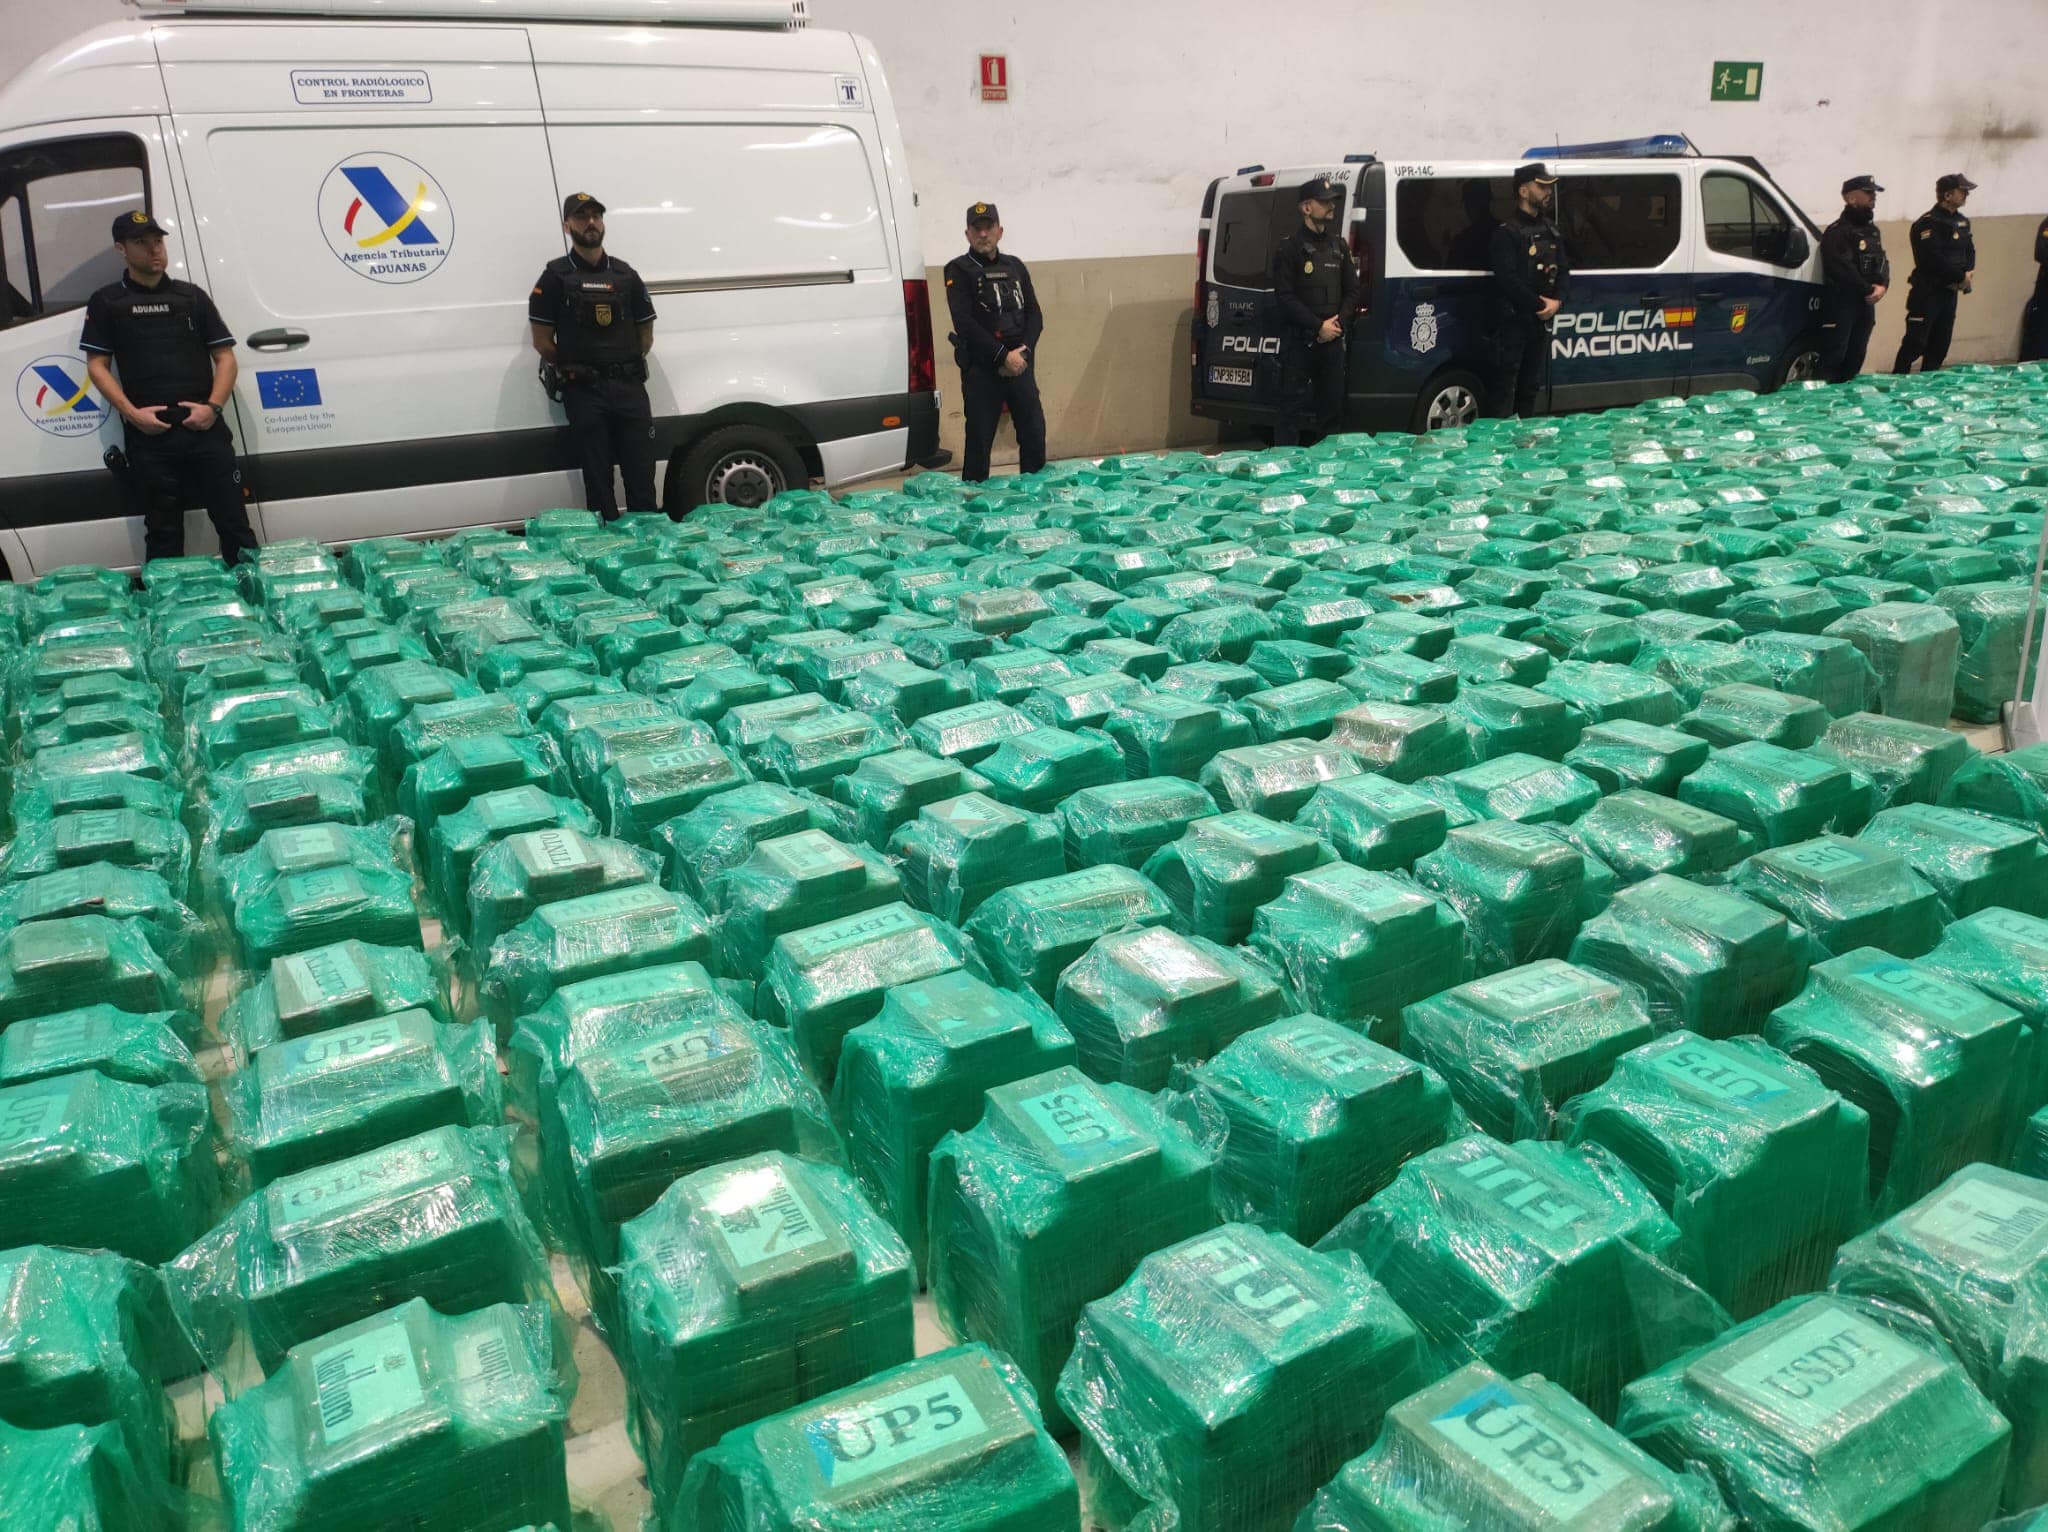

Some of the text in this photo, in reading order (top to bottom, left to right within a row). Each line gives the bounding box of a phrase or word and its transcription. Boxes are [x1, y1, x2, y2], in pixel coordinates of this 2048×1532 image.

[297, 76, 425, 87] CONTROL RADIÓLOGICO
[323, 88, 405, 98] EN FRONTERAS
[1394, 166, 1434, 176] UPR-14C
[343, 248, 446, 263] Agencia Tributaria
[369, 262, 427, 275] ADUANAS
[1222, 336, 1280, 354] POLICI
[1552, 331, 1694, 360] NACIONAL
[264, 413, 308, 424] Co-funded
[266, 424, 306, 434] European
[540, 832, 572, 866] TINTO
[810, 912, 907, 945] LEFTY
[1874, 968, 1962, 1009] UP5
[297, 1029, 392, 1065] UP5
[650, 1035, 711, 1066] UP
[1666, 1052, 1763, 1100] UP5
[1041, 1093, 1110, 1142] UP5
[1188, 1236, 1316, 1328] FIJI
[1760, 1330, 1868, 1400] USDT
[316, 1347, 378, 1429] Marlboro
[828, 1390, 963, 1463] UP5
[1462, 1400, 1602, 1496] UP5
